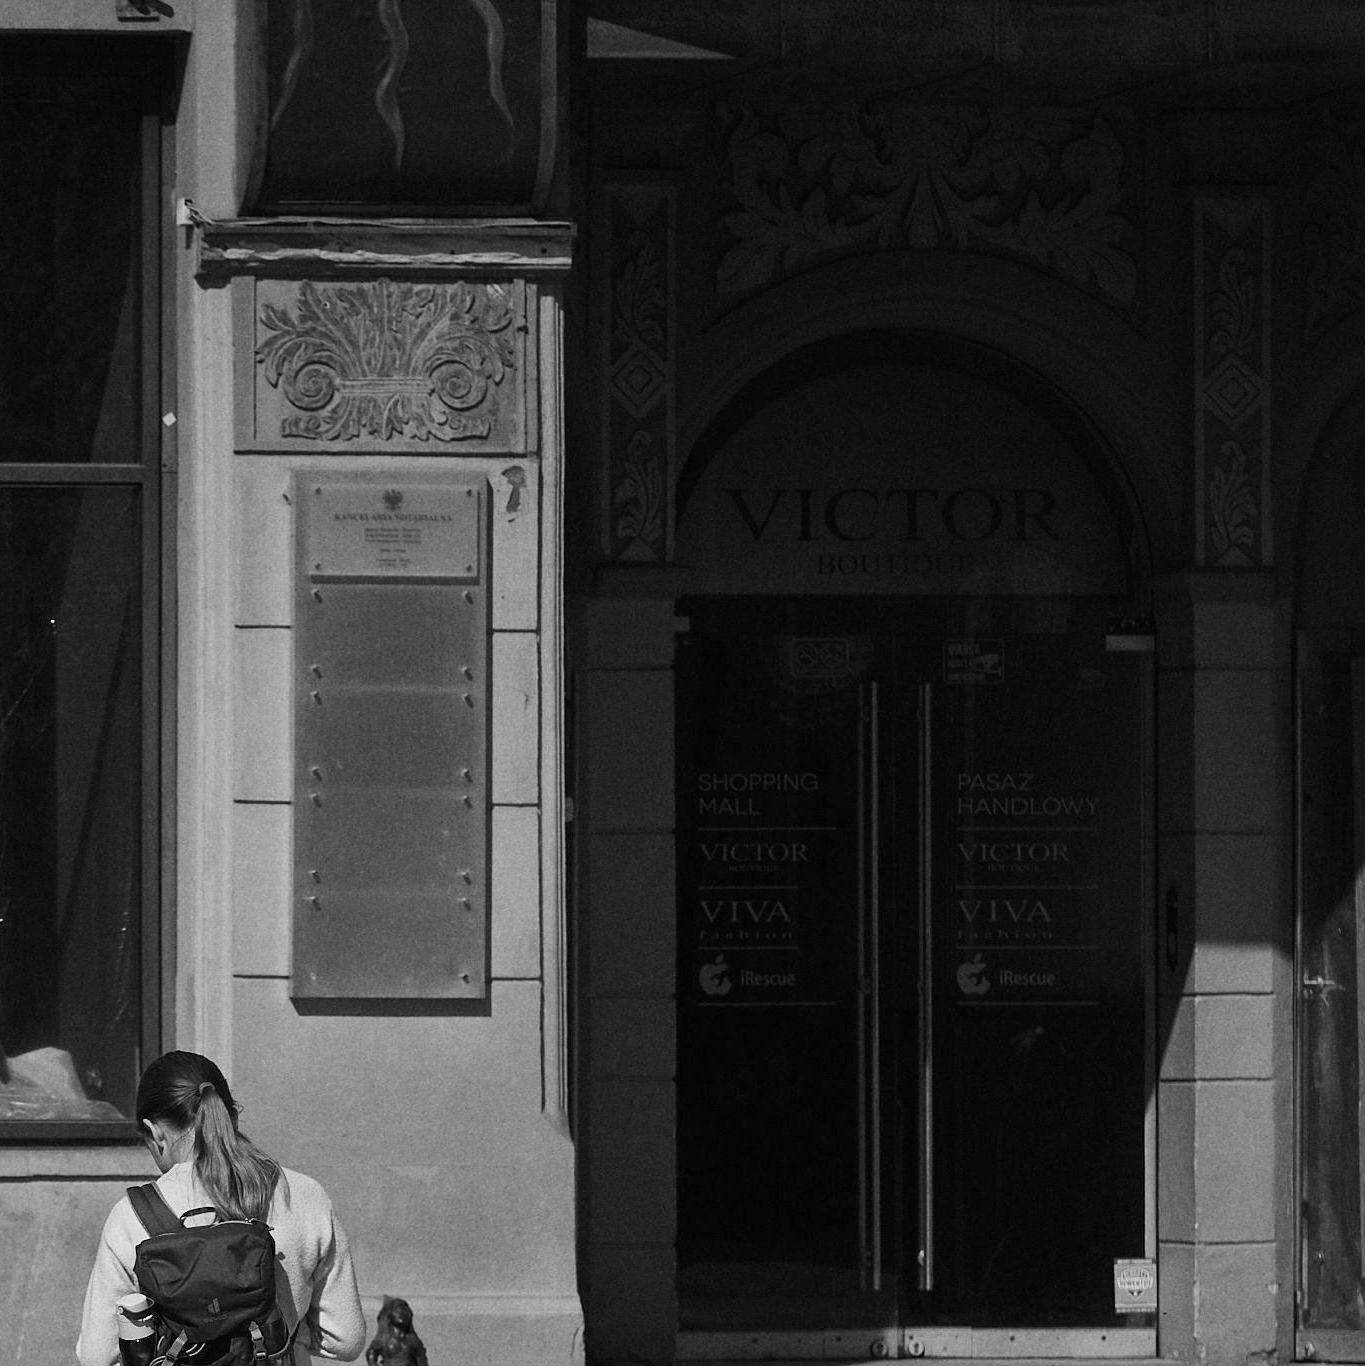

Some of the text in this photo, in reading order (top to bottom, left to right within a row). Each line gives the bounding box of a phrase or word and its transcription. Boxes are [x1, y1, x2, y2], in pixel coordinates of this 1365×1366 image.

[722, 487, 1070, 542] VICTOR
[697, 773, 819, 792] SHOPPING
[958, 771, 1034, 791] PASAŻ
[698, 798, 762, 816] MALL
[957, 797, 1100, 817] HANDLOWY
[699, 842, 809, 862] VICTOR
[958, 842, 1069, 862] VICTOR
[699, 900, 792, 923] VIVA
[958, 900, 1053, 923] VIVA
[740, 970, 796, 987] iRescue
[999, 970, 1056, 987] iRescue
